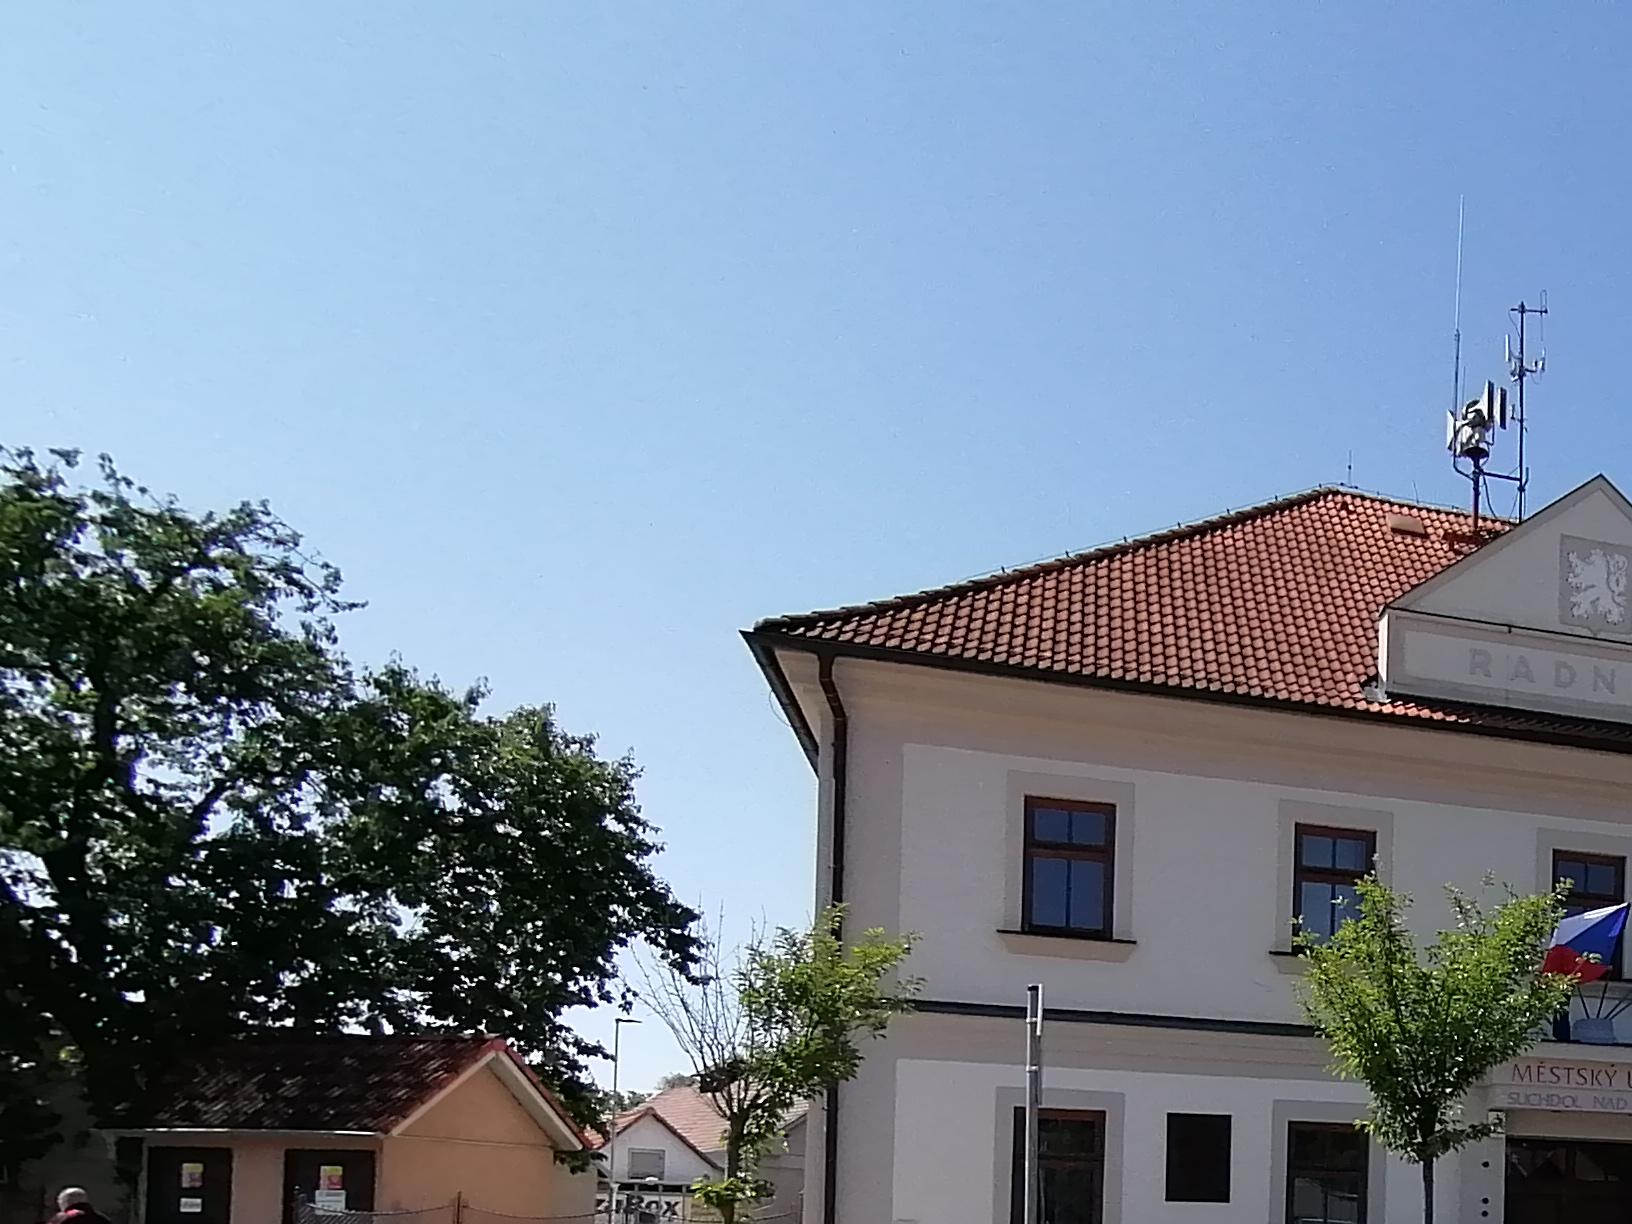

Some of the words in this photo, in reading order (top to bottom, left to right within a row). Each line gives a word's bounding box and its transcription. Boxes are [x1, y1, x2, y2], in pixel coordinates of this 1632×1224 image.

[1511, 1061, 1618, 1087] MĚSTSKÝ
[1507, 1091, 1582, 1109] SUCHDOL
[1592, 1095, 1628, 1111] NAD
